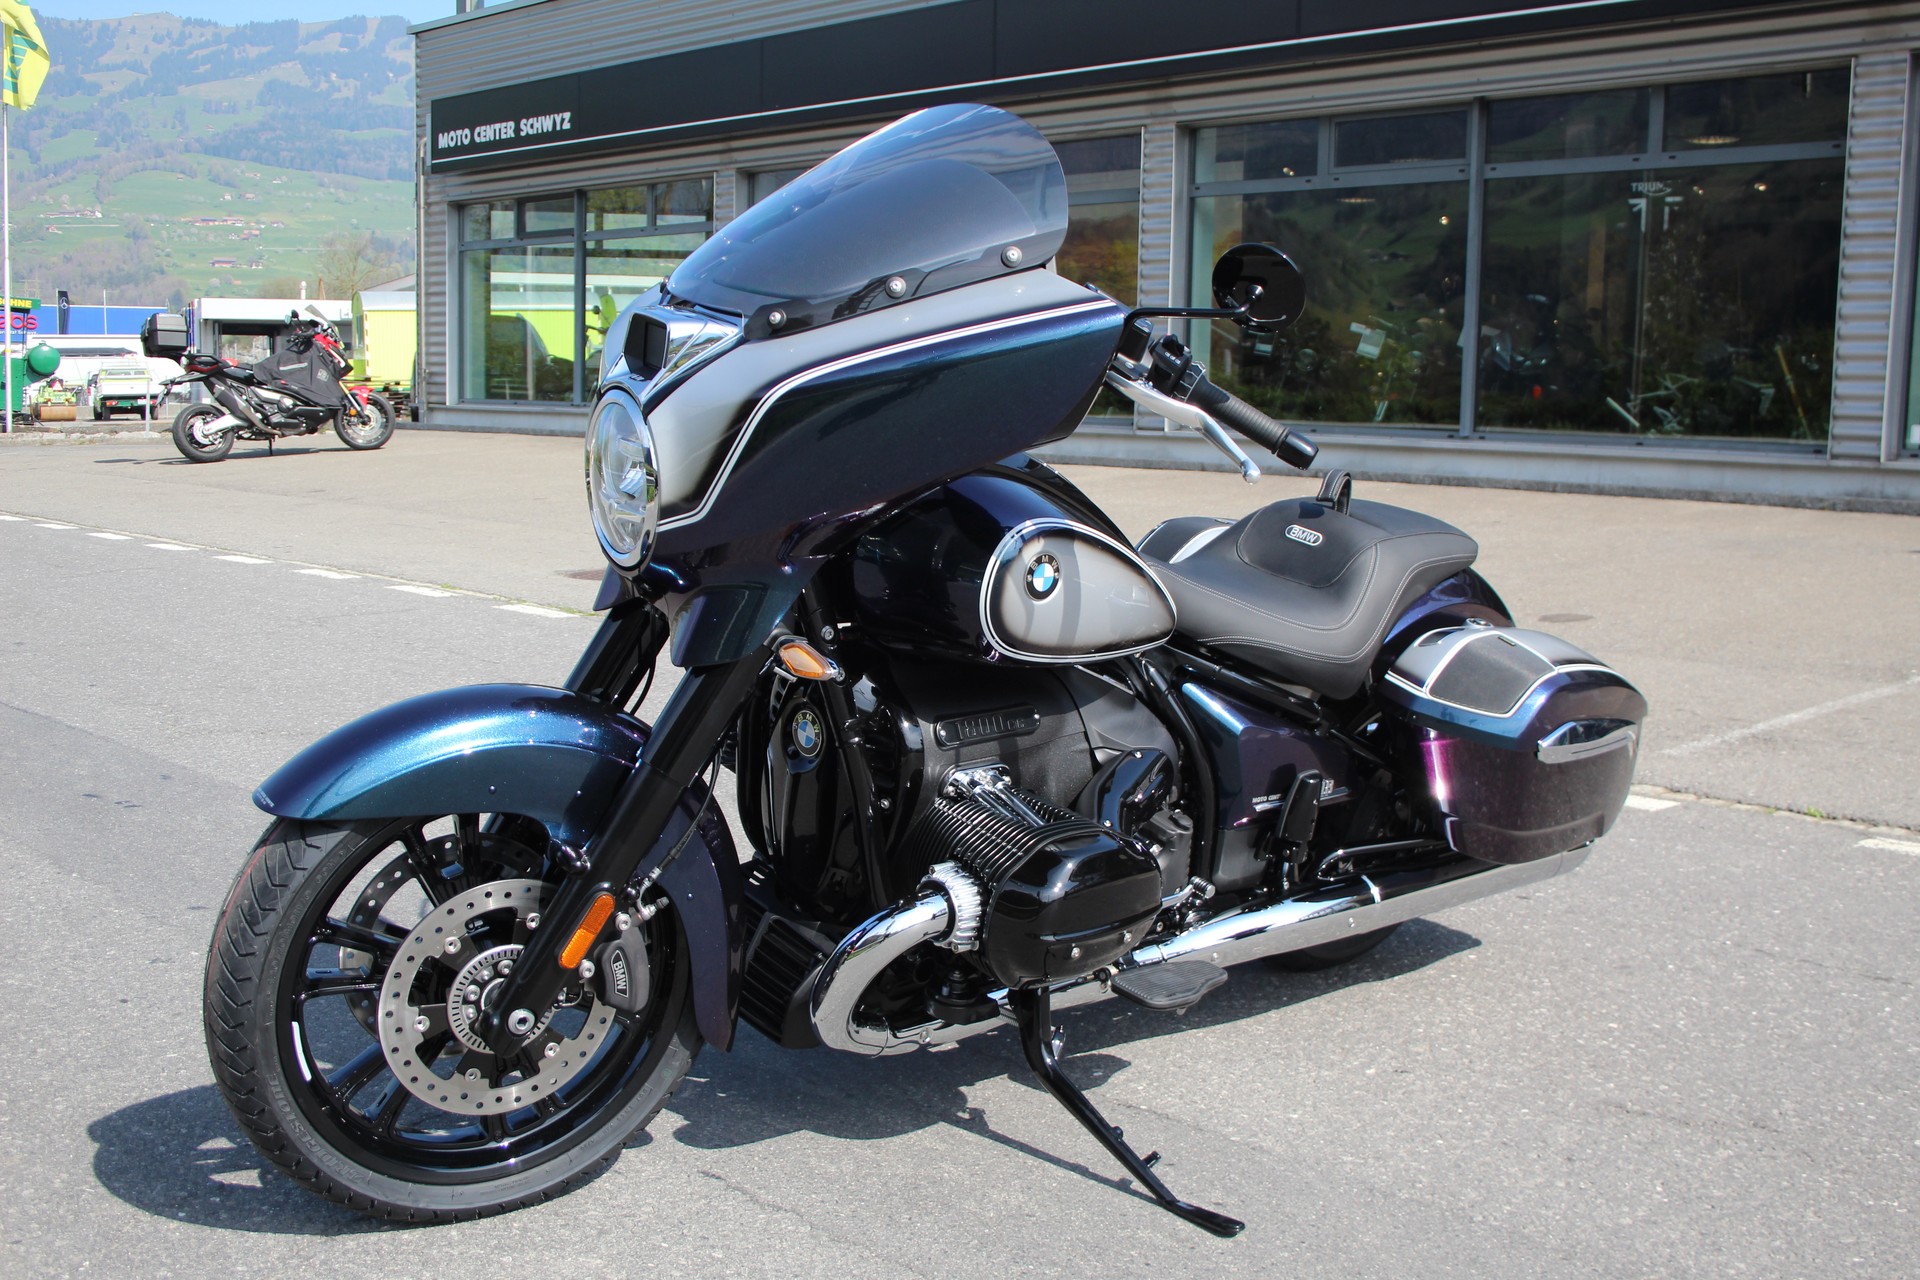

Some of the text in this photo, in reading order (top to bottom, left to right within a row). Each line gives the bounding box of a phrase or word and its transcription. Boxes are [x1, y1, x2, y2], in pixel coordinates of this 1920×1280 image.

[438, 112, 572, 149] MOTO CENTER SCHWYZ
[1631, 180, 1676, 196] TRIUM
[1289, 527, 1319, 544] BMW
[954, 713, 1005, 740] 1800
[1252, 795, 1268, 803] MOTO
[612, 959, 628, 990] BMW
[267, 1072, 366, 1182] BRIDGESTONE
